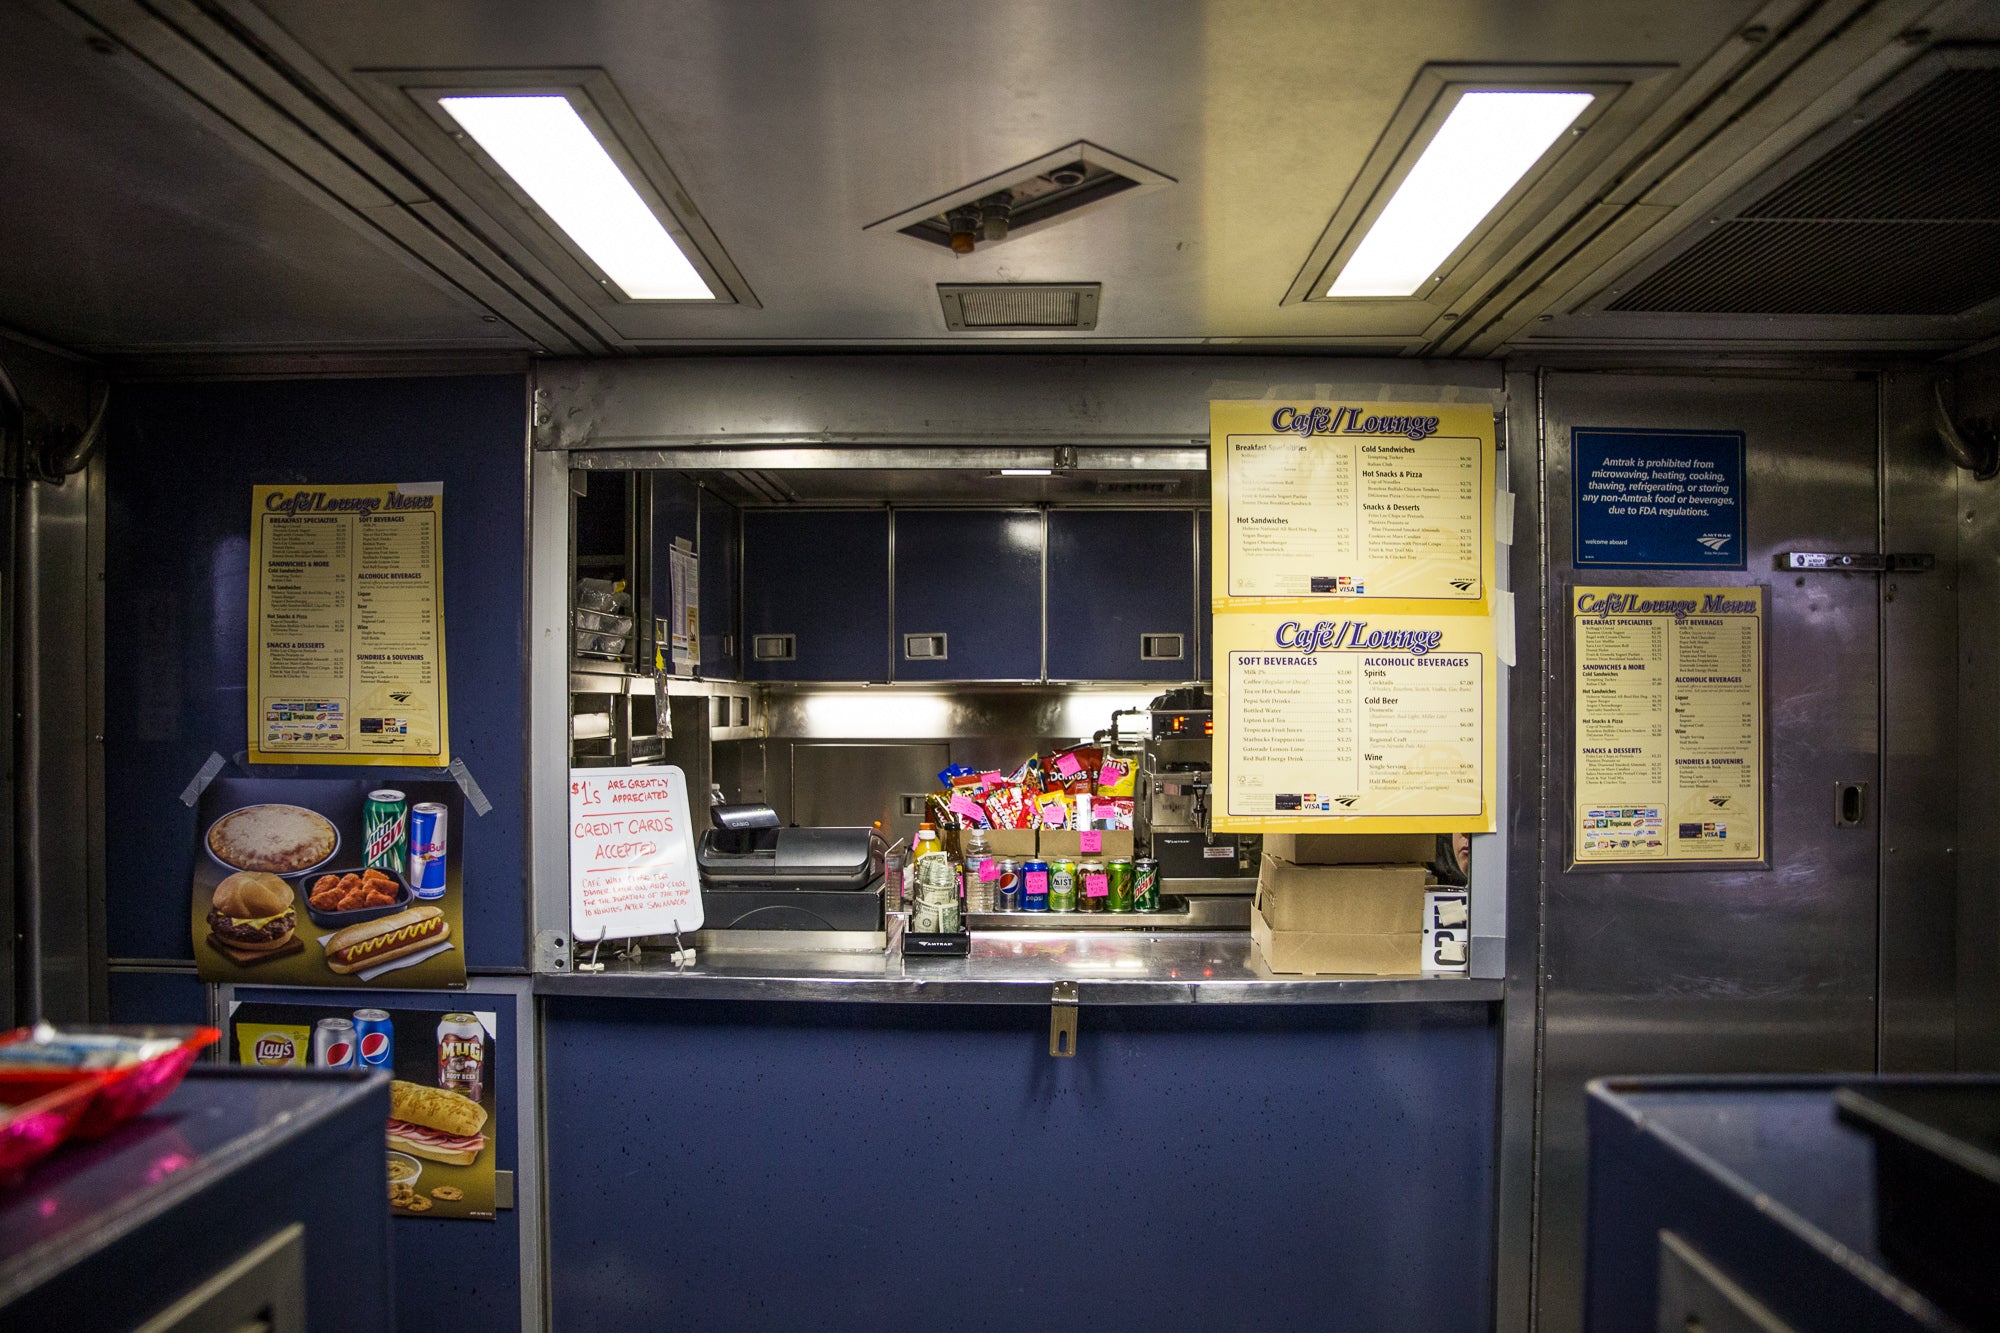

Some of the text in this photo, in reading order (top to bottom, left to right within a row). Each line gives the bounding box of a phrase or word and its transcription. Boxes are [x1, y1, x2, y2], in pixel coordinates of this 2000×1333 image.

[1272, 407, 1438, 439] Café/Lounge
[1602, 458, 1714, 471] Amtrak is prohibited from
[1592, 469, 1725, 482] microwaving, heating, cooking,
[1588, 481, 1626, 492] thawing,
[1629, 482, 1685, 493] refrigerating,
[1698, 484, 1728, 494] storing
[383, 491, 434, 509] Menu
[1582, 494, 1598, 503] any
[1601, 494, 1652, 502] non-Amtrak
[1654, 494, 1675, 503] food
[1689, 495, 1734, 506] beverages,
[1608, 506, 1709, 517] due to FDA regulations.
[1578, 593, 1756, 619] Café/Lounge Menu
[1275, 620, 1442, 655] Café/Lounge
[1238, 657, 1318, 666] SOFT BEVERAGES
[1364, 658, 1469, 667] ALCOHOLIC BEVERAGES
[1364, 670, 1386, 678] Spirits
[608, 780, 627, 790] ARE
[628, 779, 669, 789] GREATLY
[612, 790, 668, 803] APPRECIATED
[575, 817, 673, 838] CREDIT CARDS
[595, 841, 656, 860] ACCEPTED
[258, 1040, 291, 1059] Lay's
[442, 1042, 480, 1061] MUG
